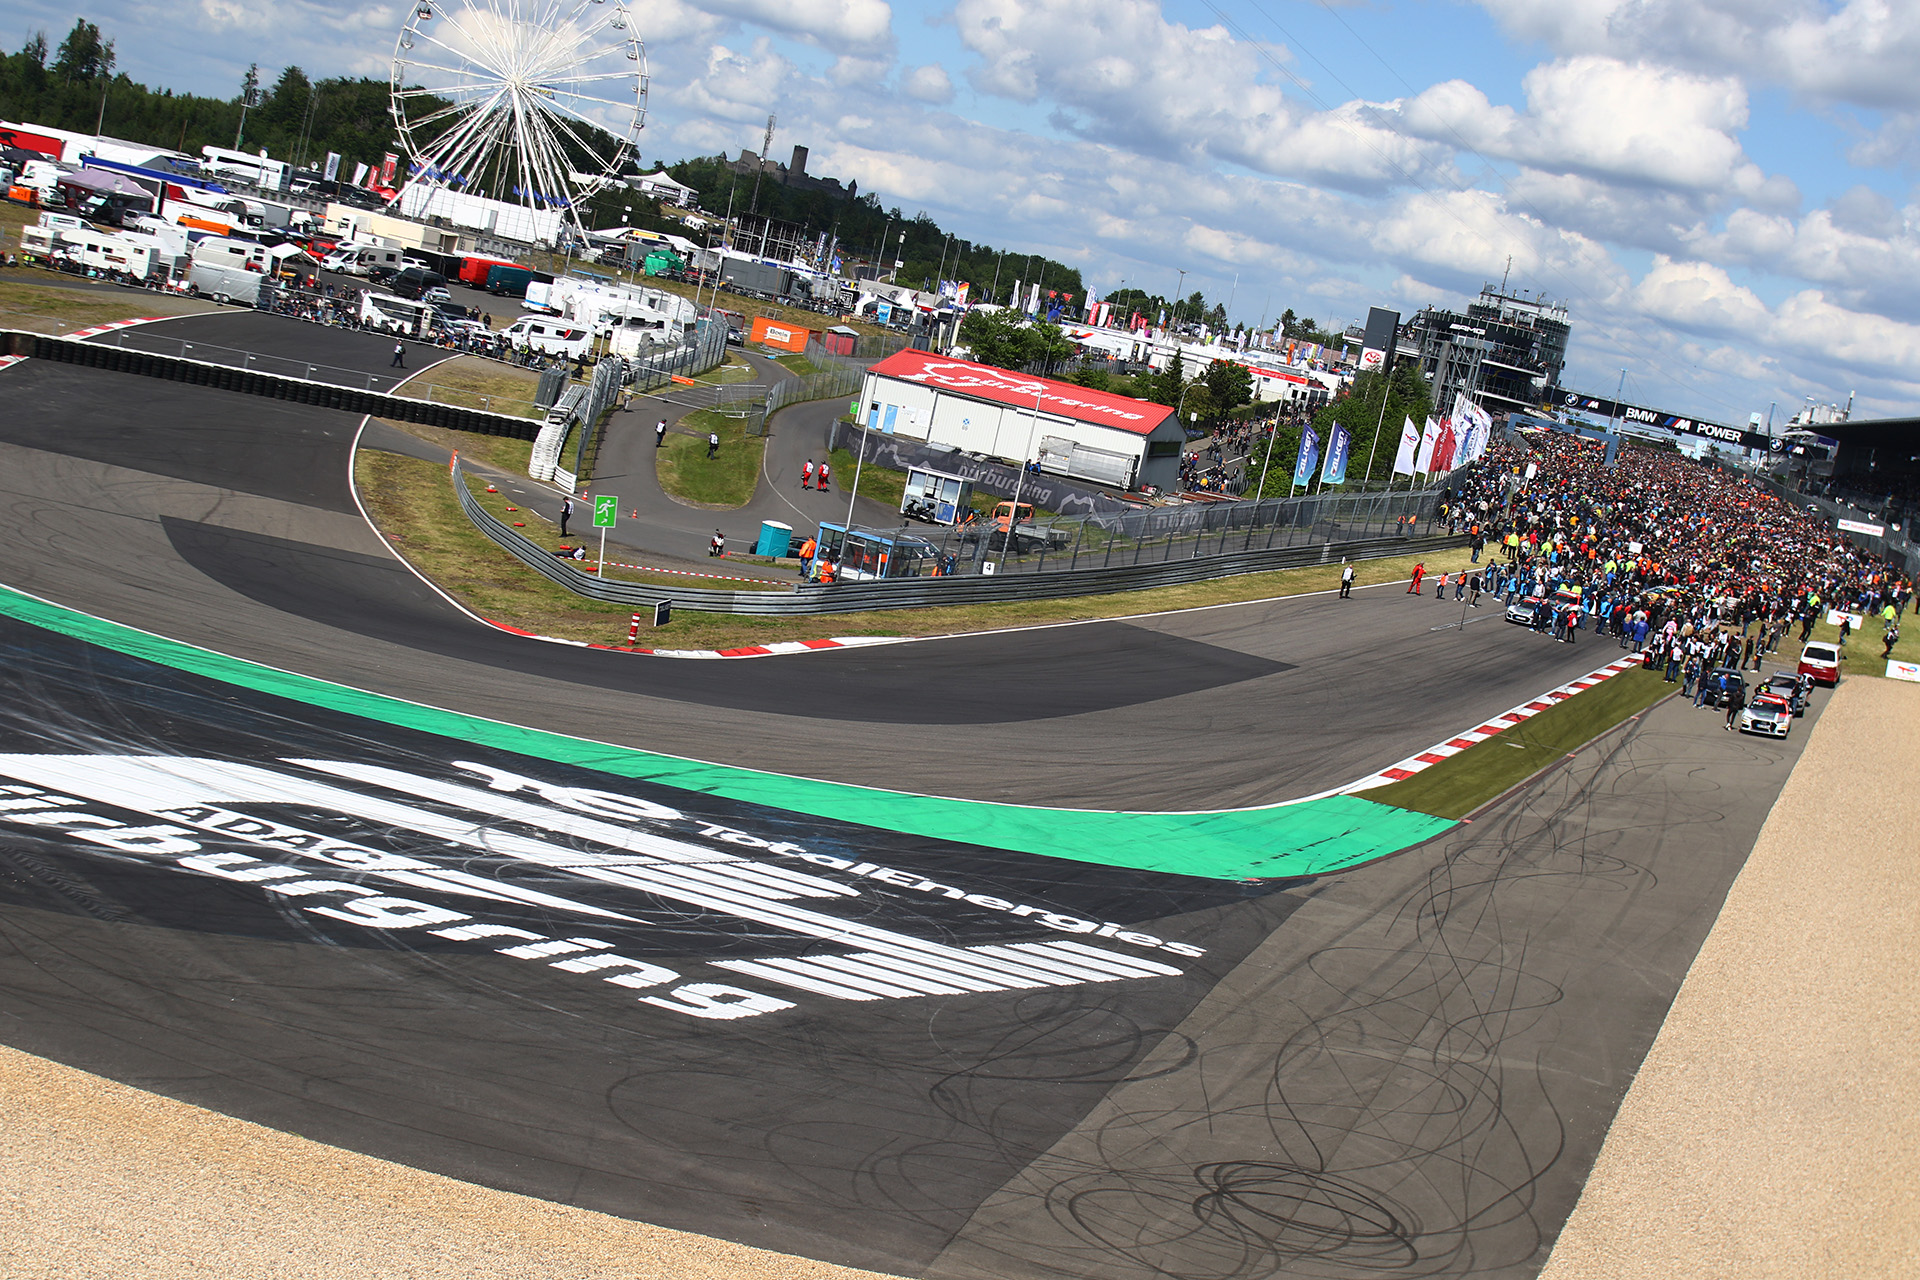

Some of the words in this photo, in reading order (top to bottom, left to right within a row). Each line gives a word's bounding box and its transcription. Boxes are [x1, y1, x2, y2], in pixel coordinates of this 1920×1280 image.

[1625, 407, 1658, 423] BMW
[1696, 422, 1742, 443] POWER
[1330, 431, 1345, 477] FALKEN
[985, 563, 992, 571] 4
[152, 805, 383, 864] ADAC
[695, 819, 1207, 958] TotalEnergies
